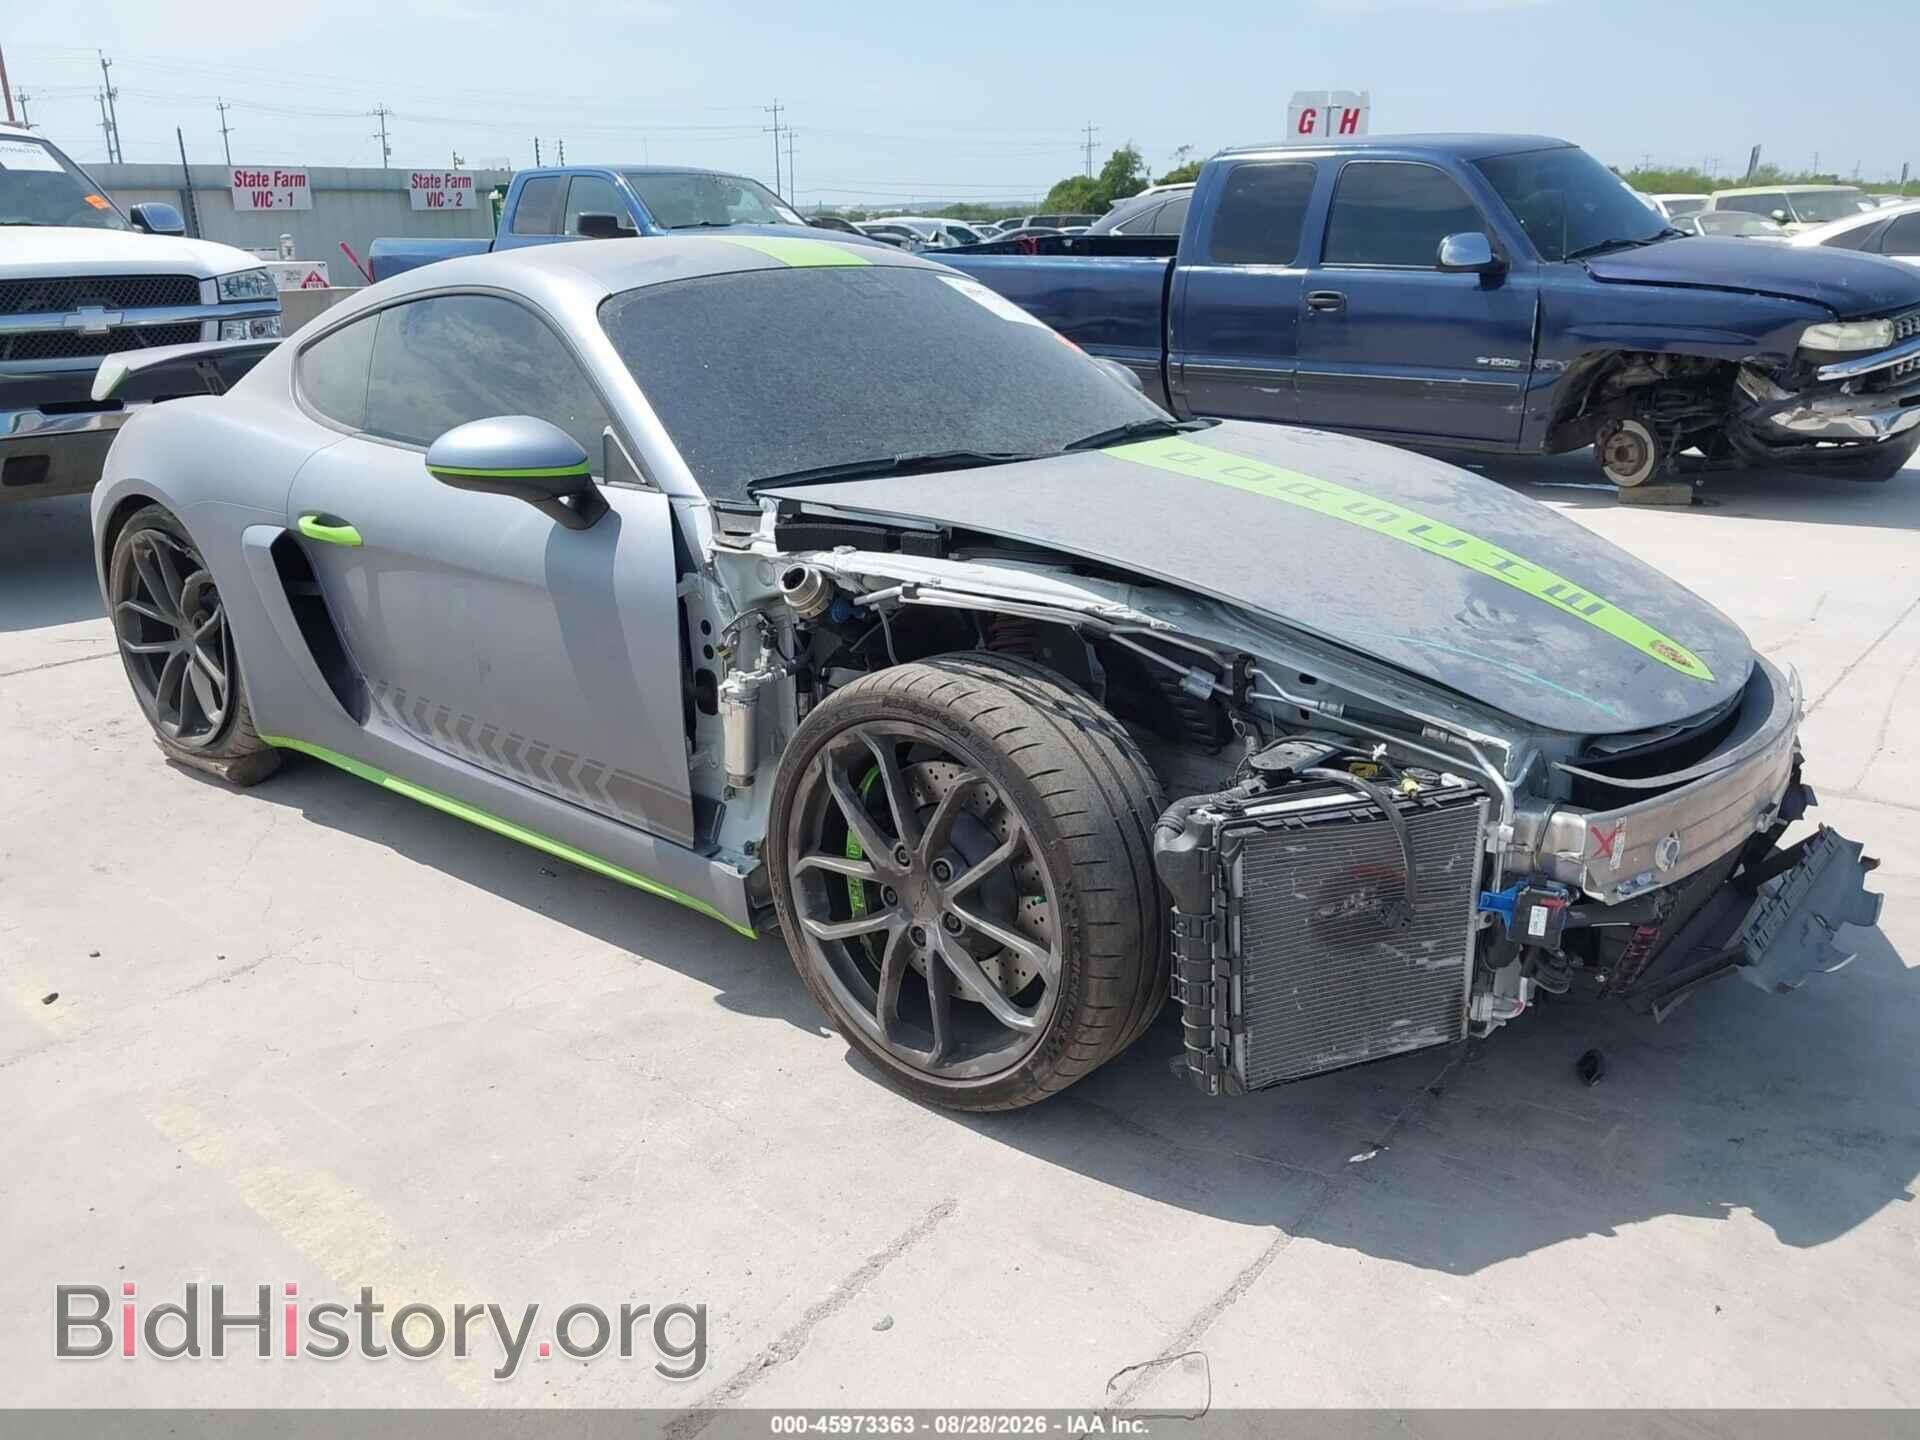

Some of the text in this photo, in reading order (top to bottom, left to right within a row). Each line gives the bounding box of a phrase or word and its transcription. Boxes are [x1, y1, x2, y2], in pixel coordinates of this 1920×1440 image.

[1298, 108, 1317, 134] G
[1339, 108, 1360, 134] H
[234, 170, 306, 188] State Farm
[411, 172, 472, 189] State Farm
[252, 190, 273, 208] VIC
[287, 191, 293, 207] 1
[426, 191, 445, 208] VIC
[455, 191, 463, 207] 2
[1161, 451, 1606, 617] PORSCHE
